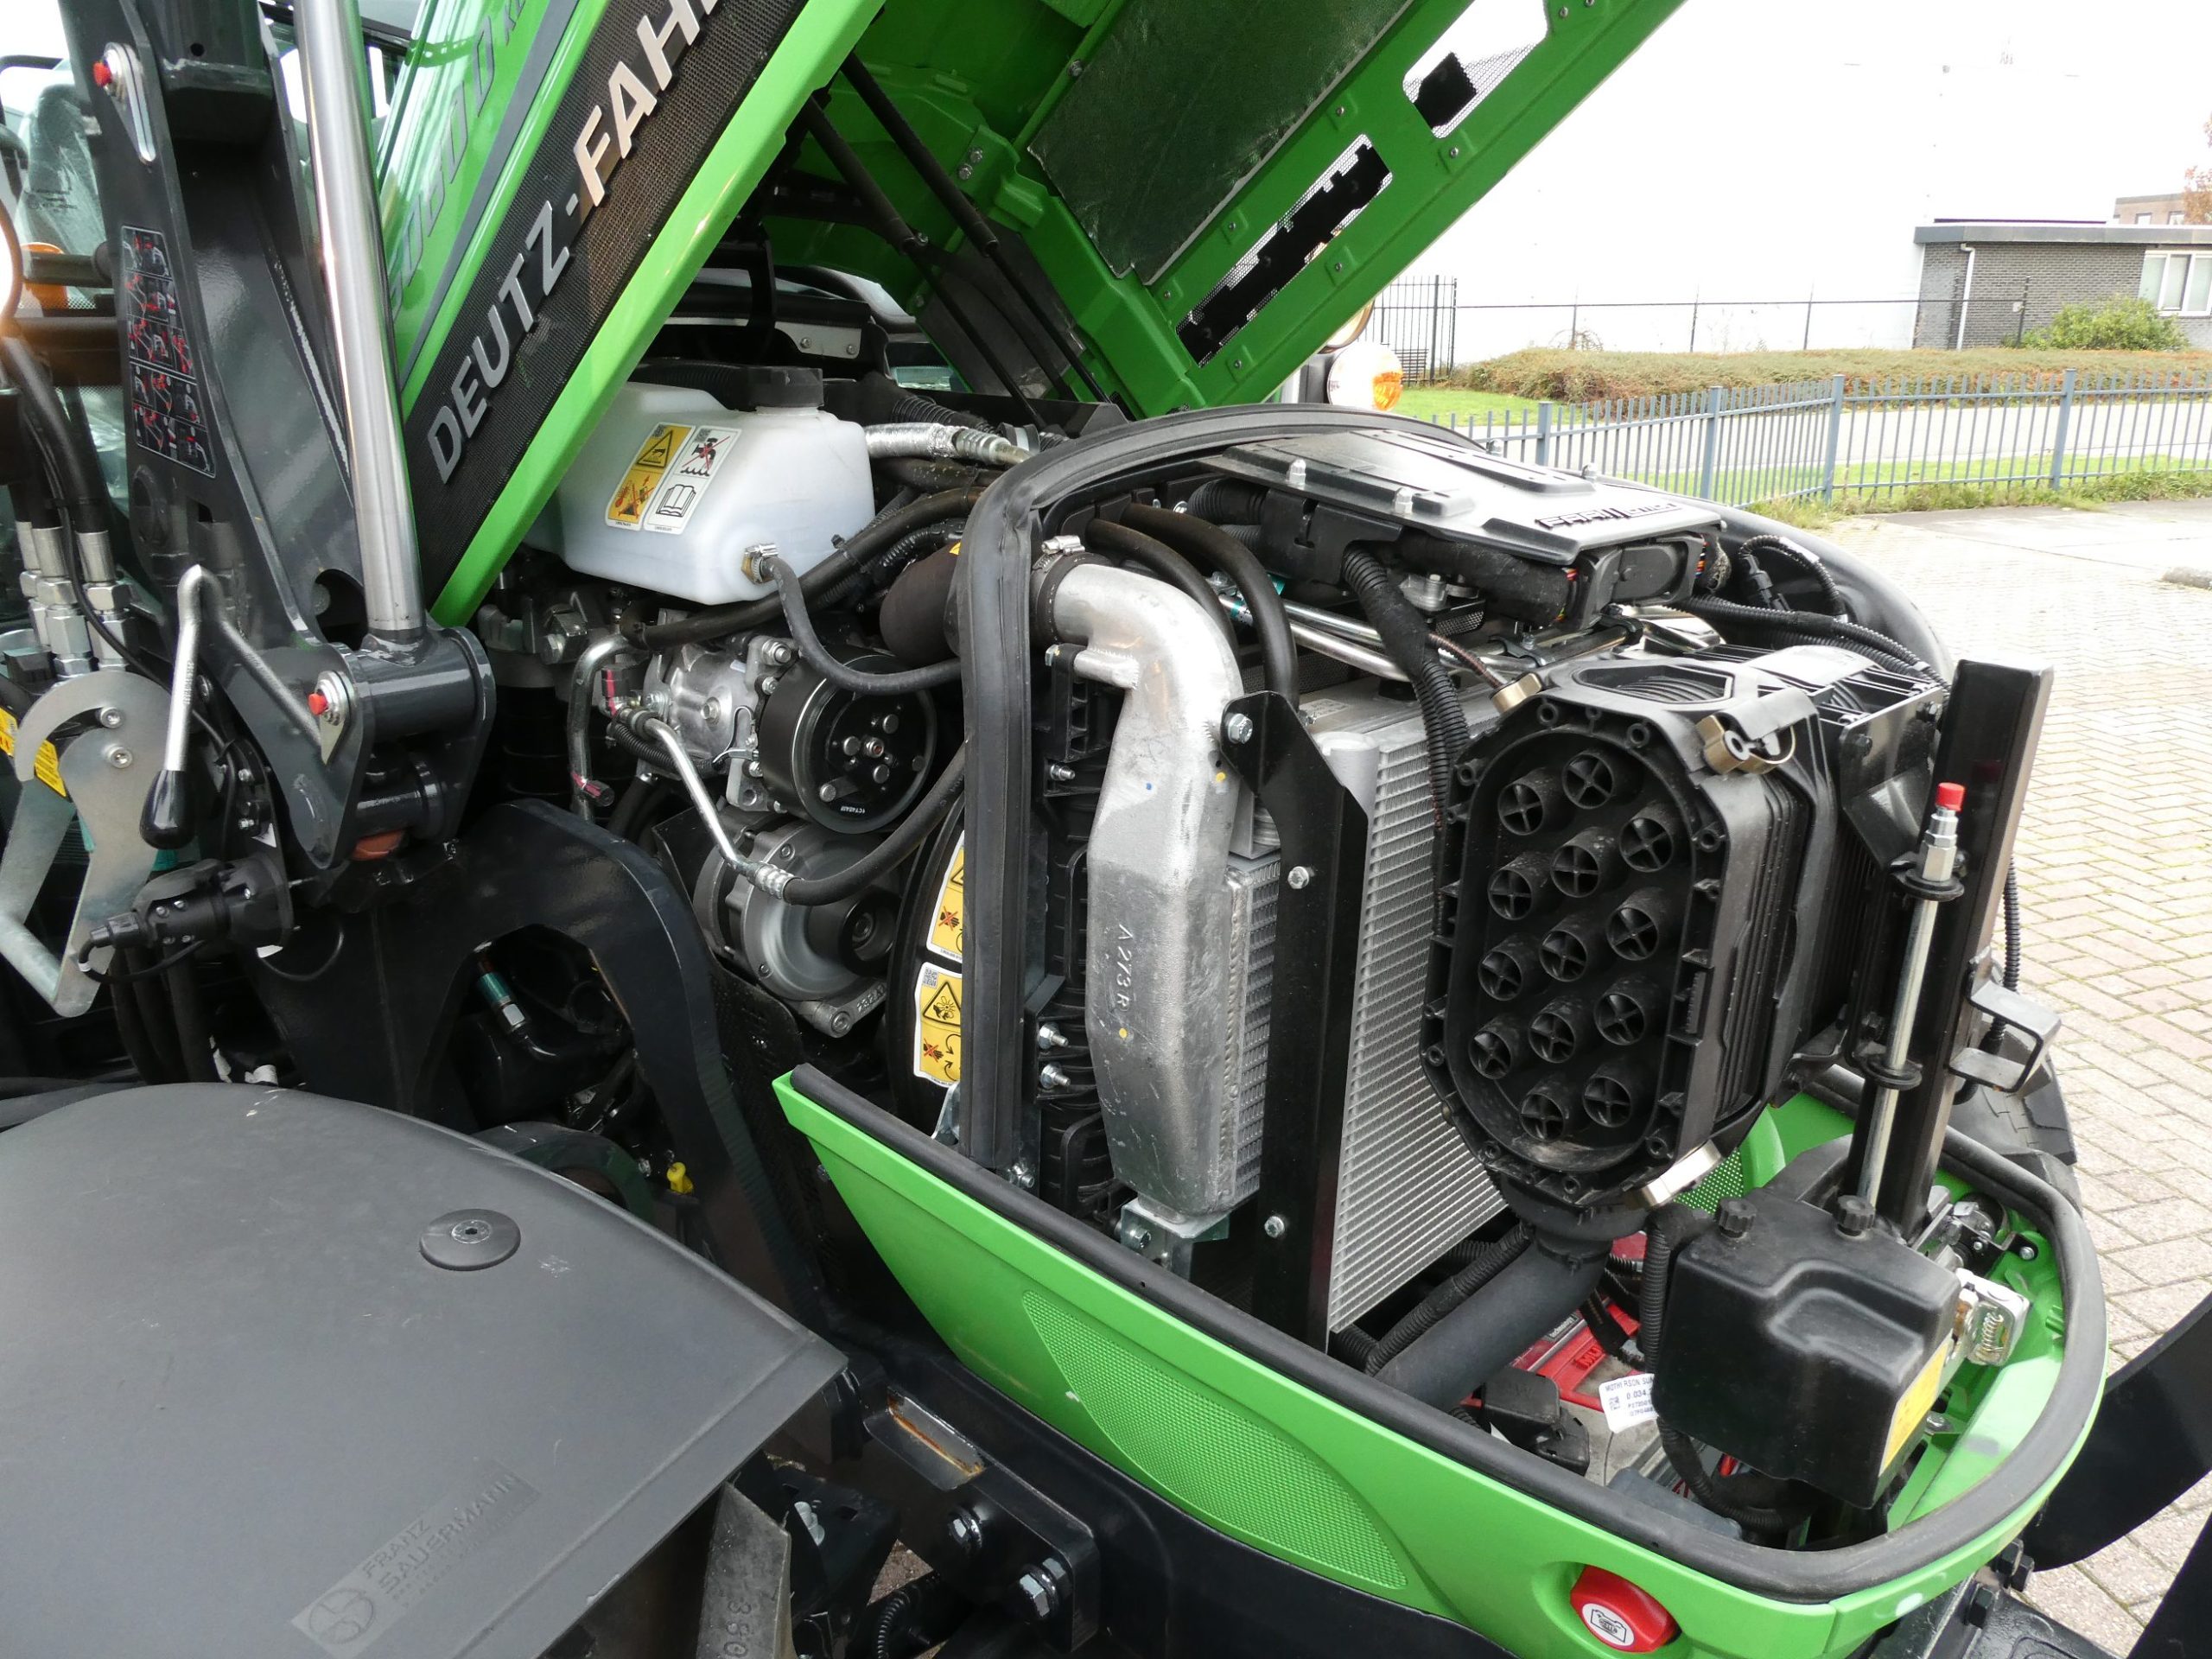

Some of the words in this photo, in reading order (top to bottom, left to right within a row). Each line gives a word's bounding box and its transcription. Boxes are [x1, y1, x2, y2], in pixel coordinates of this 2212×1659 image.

[428, 0, 717, 484] DEUTZ-FAH
[362, 1517, 430, 1580] FRANZ
[378, 1472, 522, 1595] SAUERMANN
